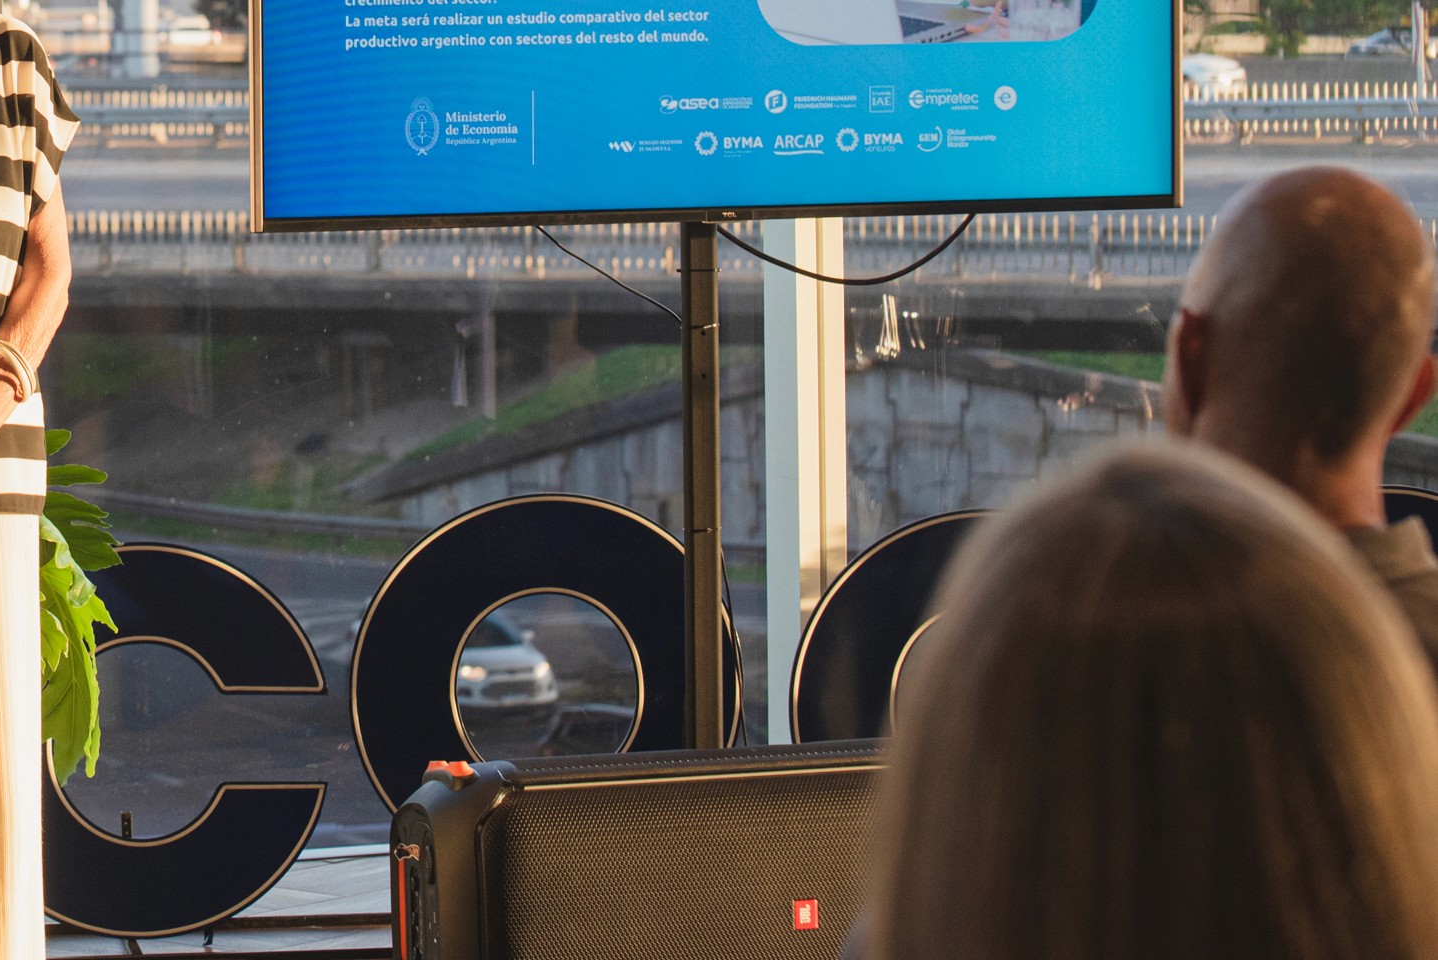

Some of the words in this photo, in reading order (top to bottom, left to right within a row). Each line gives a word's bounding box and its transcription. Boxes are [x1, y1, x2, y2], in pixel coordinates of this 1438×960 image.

[345, 15, 361, 28] La
[364, 15, 398, 27] meta
[401, 13, 430, 27] será
[433, 12, 484, 26] realizar
[487, 15, 503, 25] un
[506, 11, 556, 25] estudio
[559, 10, 641, 26] comparativo
[644, 9, 665, 22] del
[667, 10, 710, 22] sector
[345, 35, 418, 51] productivo
[421, 34, 486, 49] argentino
[489, 36, 512, 46] con
[516, 33, 572, 46] sectores
[575, 31, 596, 44] del
[599, 32, 634, 44] resto
[637, 30, 658, 44] del
[662, 29, 709, 43] mundo.
[679, 97, 719, 110] asea
[872, 96, 891, 107] IAE
[445, 110, 507, 123] Ministerio
[445, 124, 459, 135] de
[462, 122, 518, 135] Economía
[446, 137, 480, 146] República
[481, 136, 517, 146] Argentina
[723, 136, 764, 149] BYMA
[774, 134, 825, 149] ARCAP
[864, 133, 904, 146] BYMA
[864, 145, 895, 153] ventures
